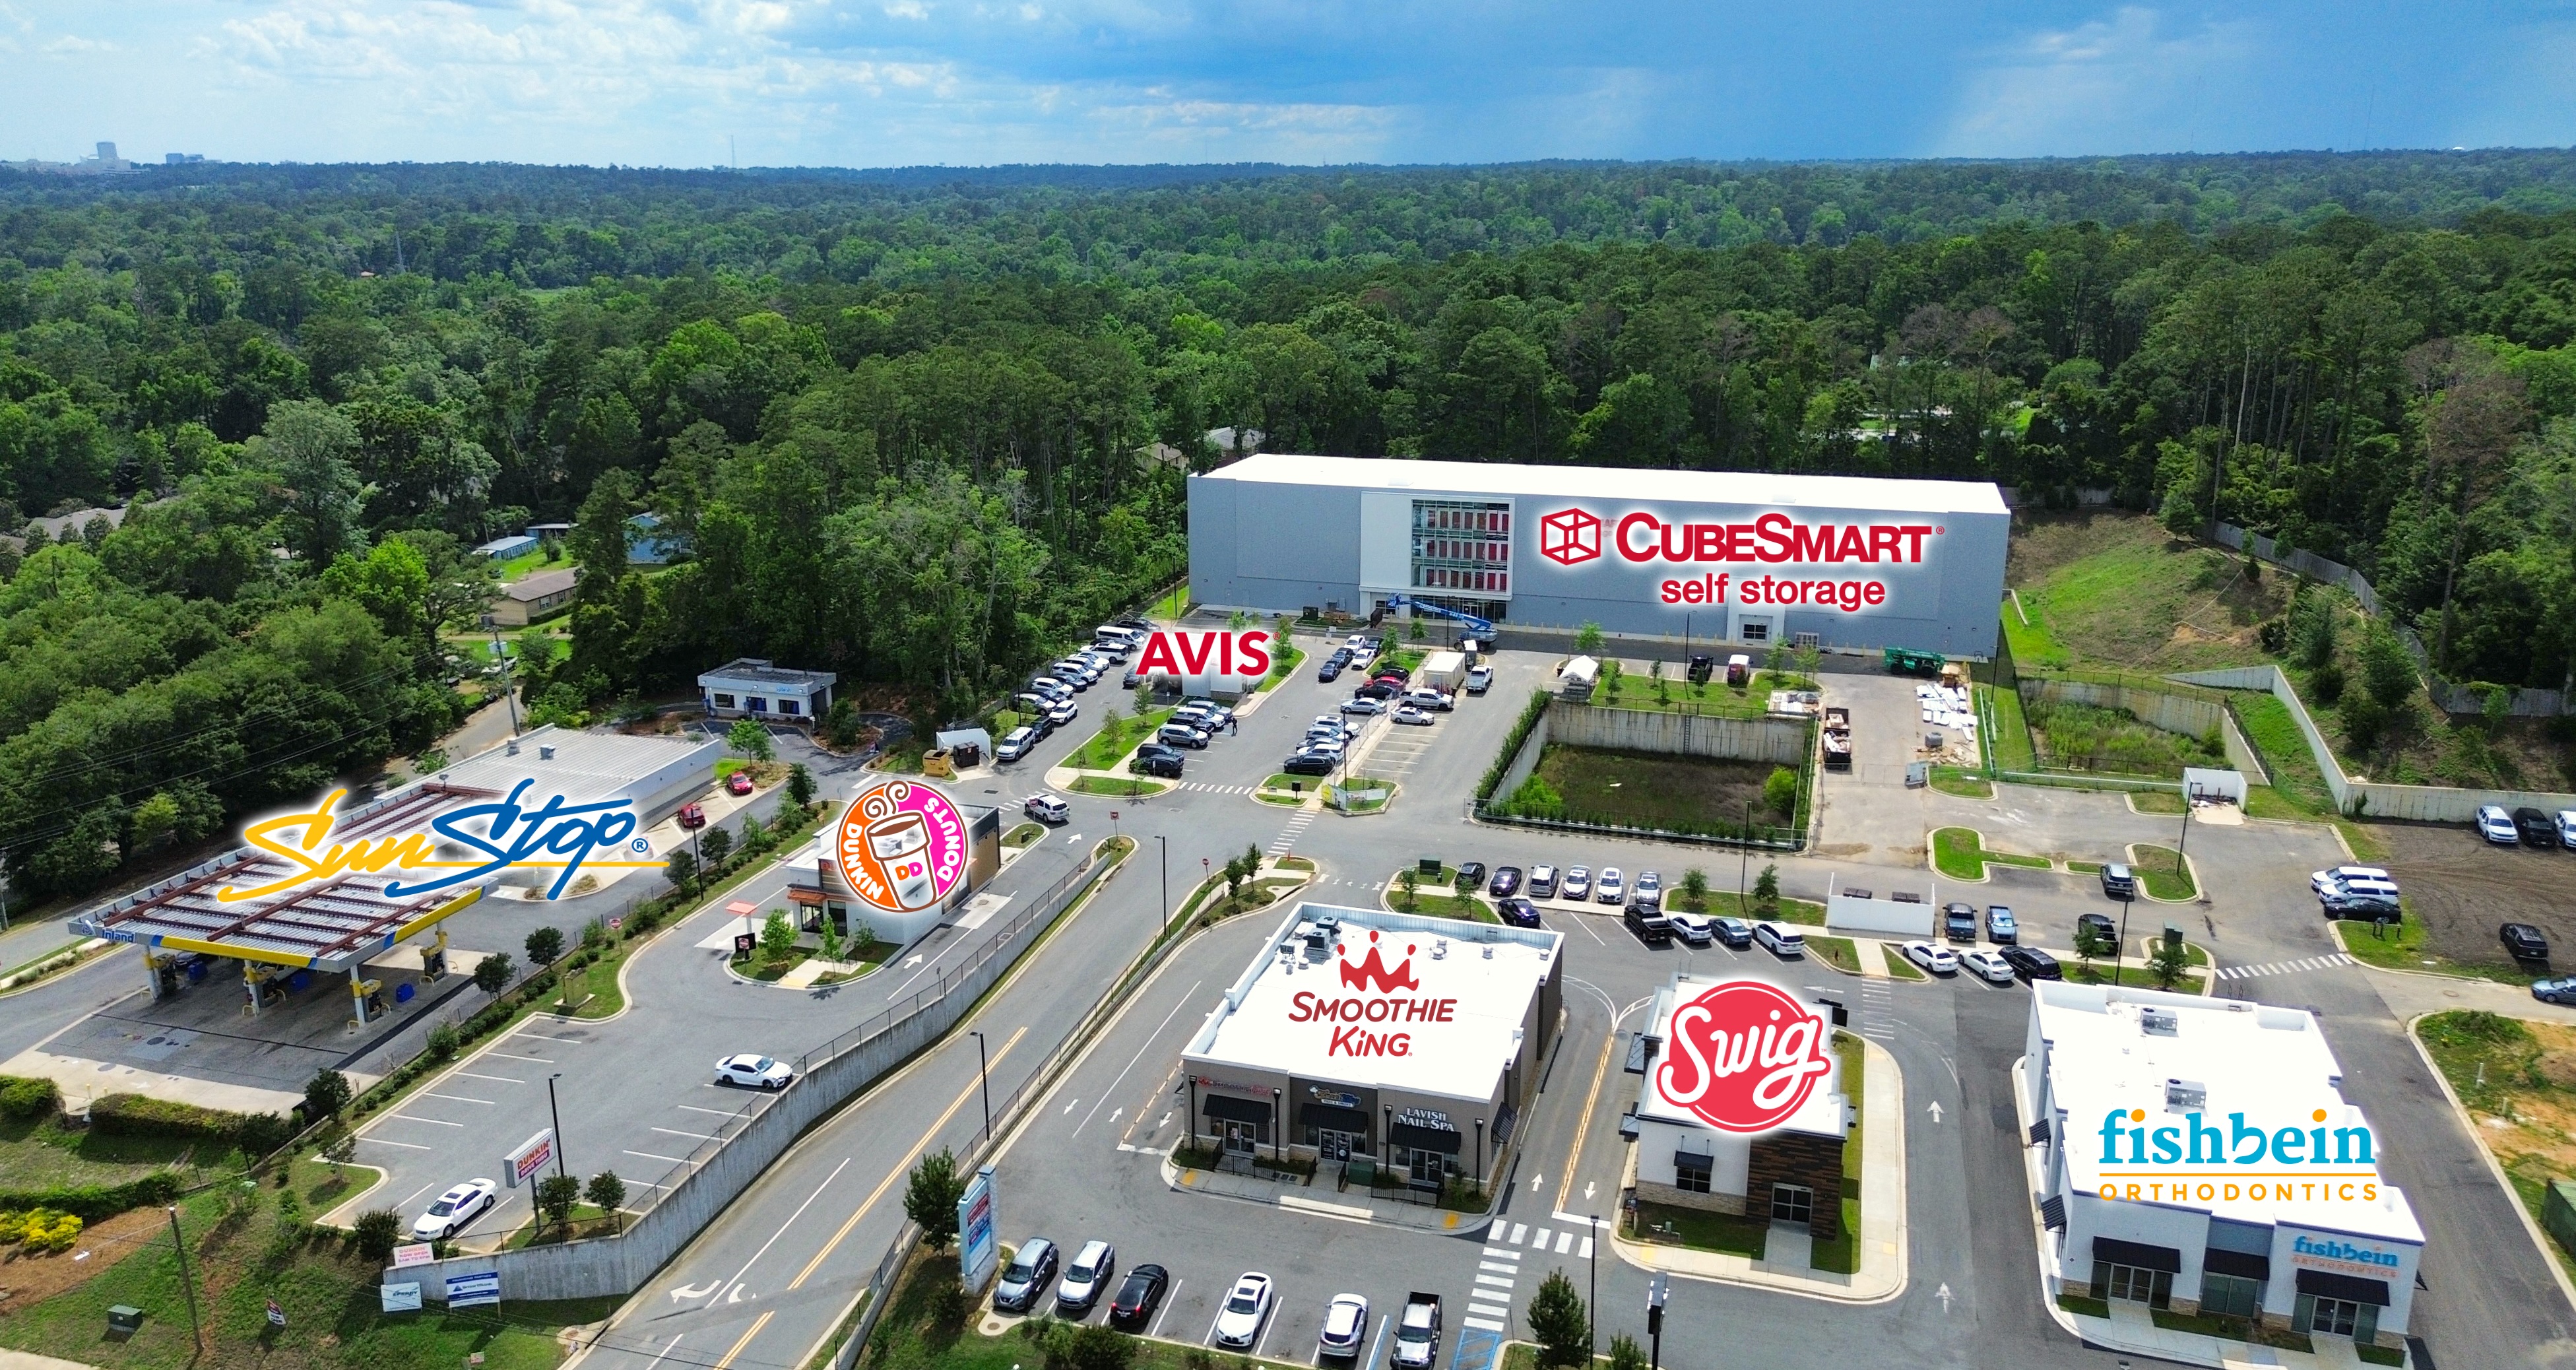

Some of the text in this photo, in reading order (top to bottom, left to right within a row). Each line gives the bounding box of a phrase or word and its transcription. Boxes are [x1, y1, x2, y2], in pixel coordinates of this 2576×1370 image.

[102, 929, 135, 943] Inland
[1407, 1107, 1446, 1121] LAVISH
[1398, 1114, 1455, 1132] NAIL SPA
[2293, 1235, 2397, 1266] fishbein
